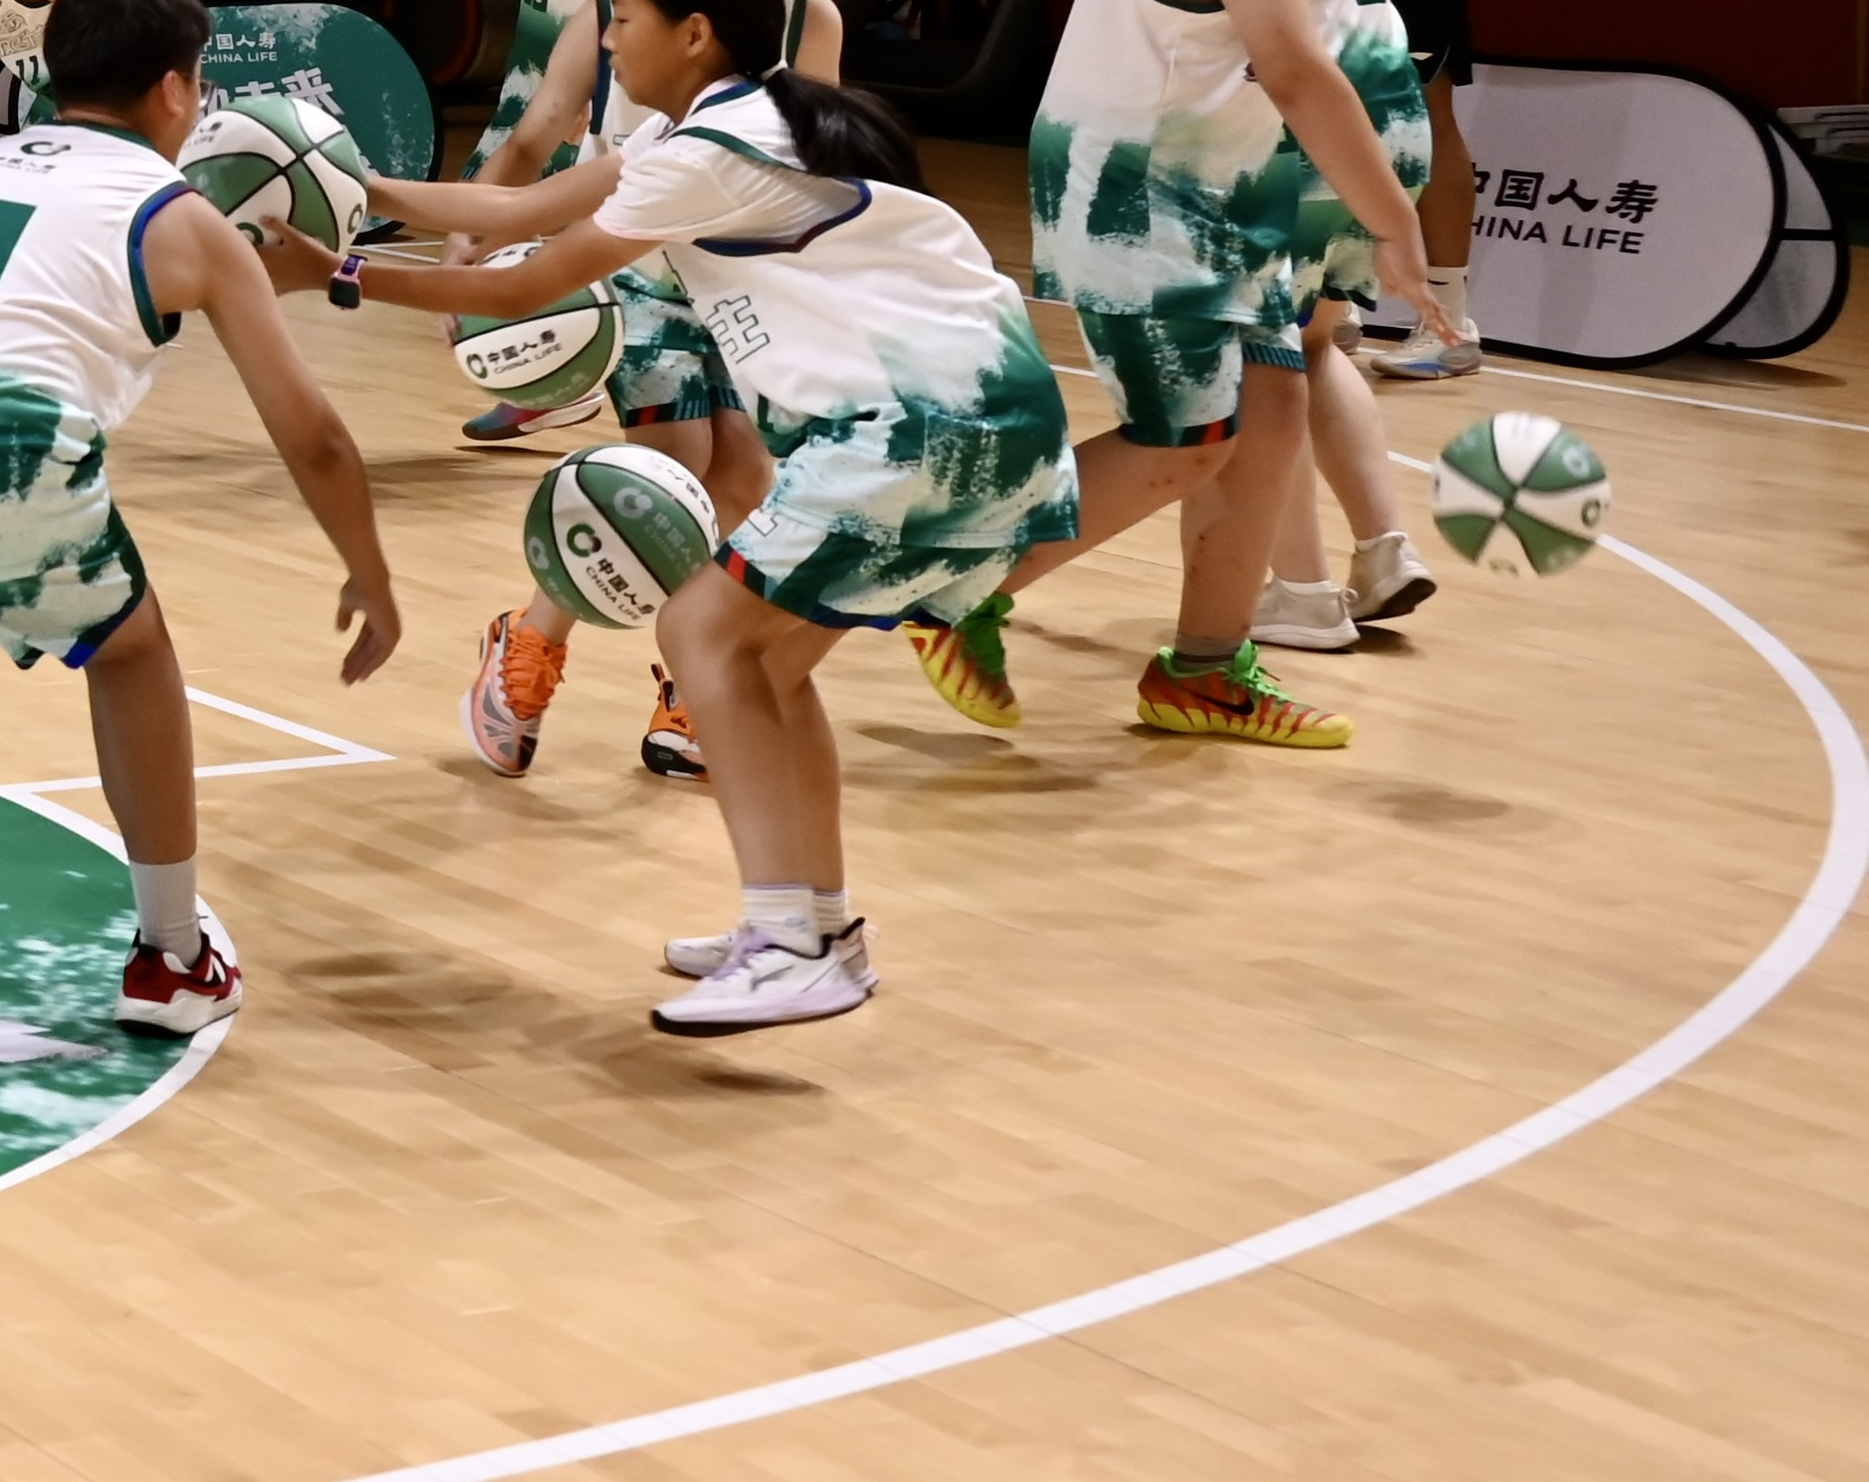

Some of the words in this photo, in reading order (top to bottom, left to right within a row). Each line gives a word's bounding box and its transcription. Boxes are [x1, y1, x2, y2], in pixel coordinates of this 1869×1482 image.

[200, 54, 242, 64] CHINA
[248, 52, 278, 63] LIFE
[1562, 224, 1645, 254] LIFE
[585, 565, 620, 605] CHINA
